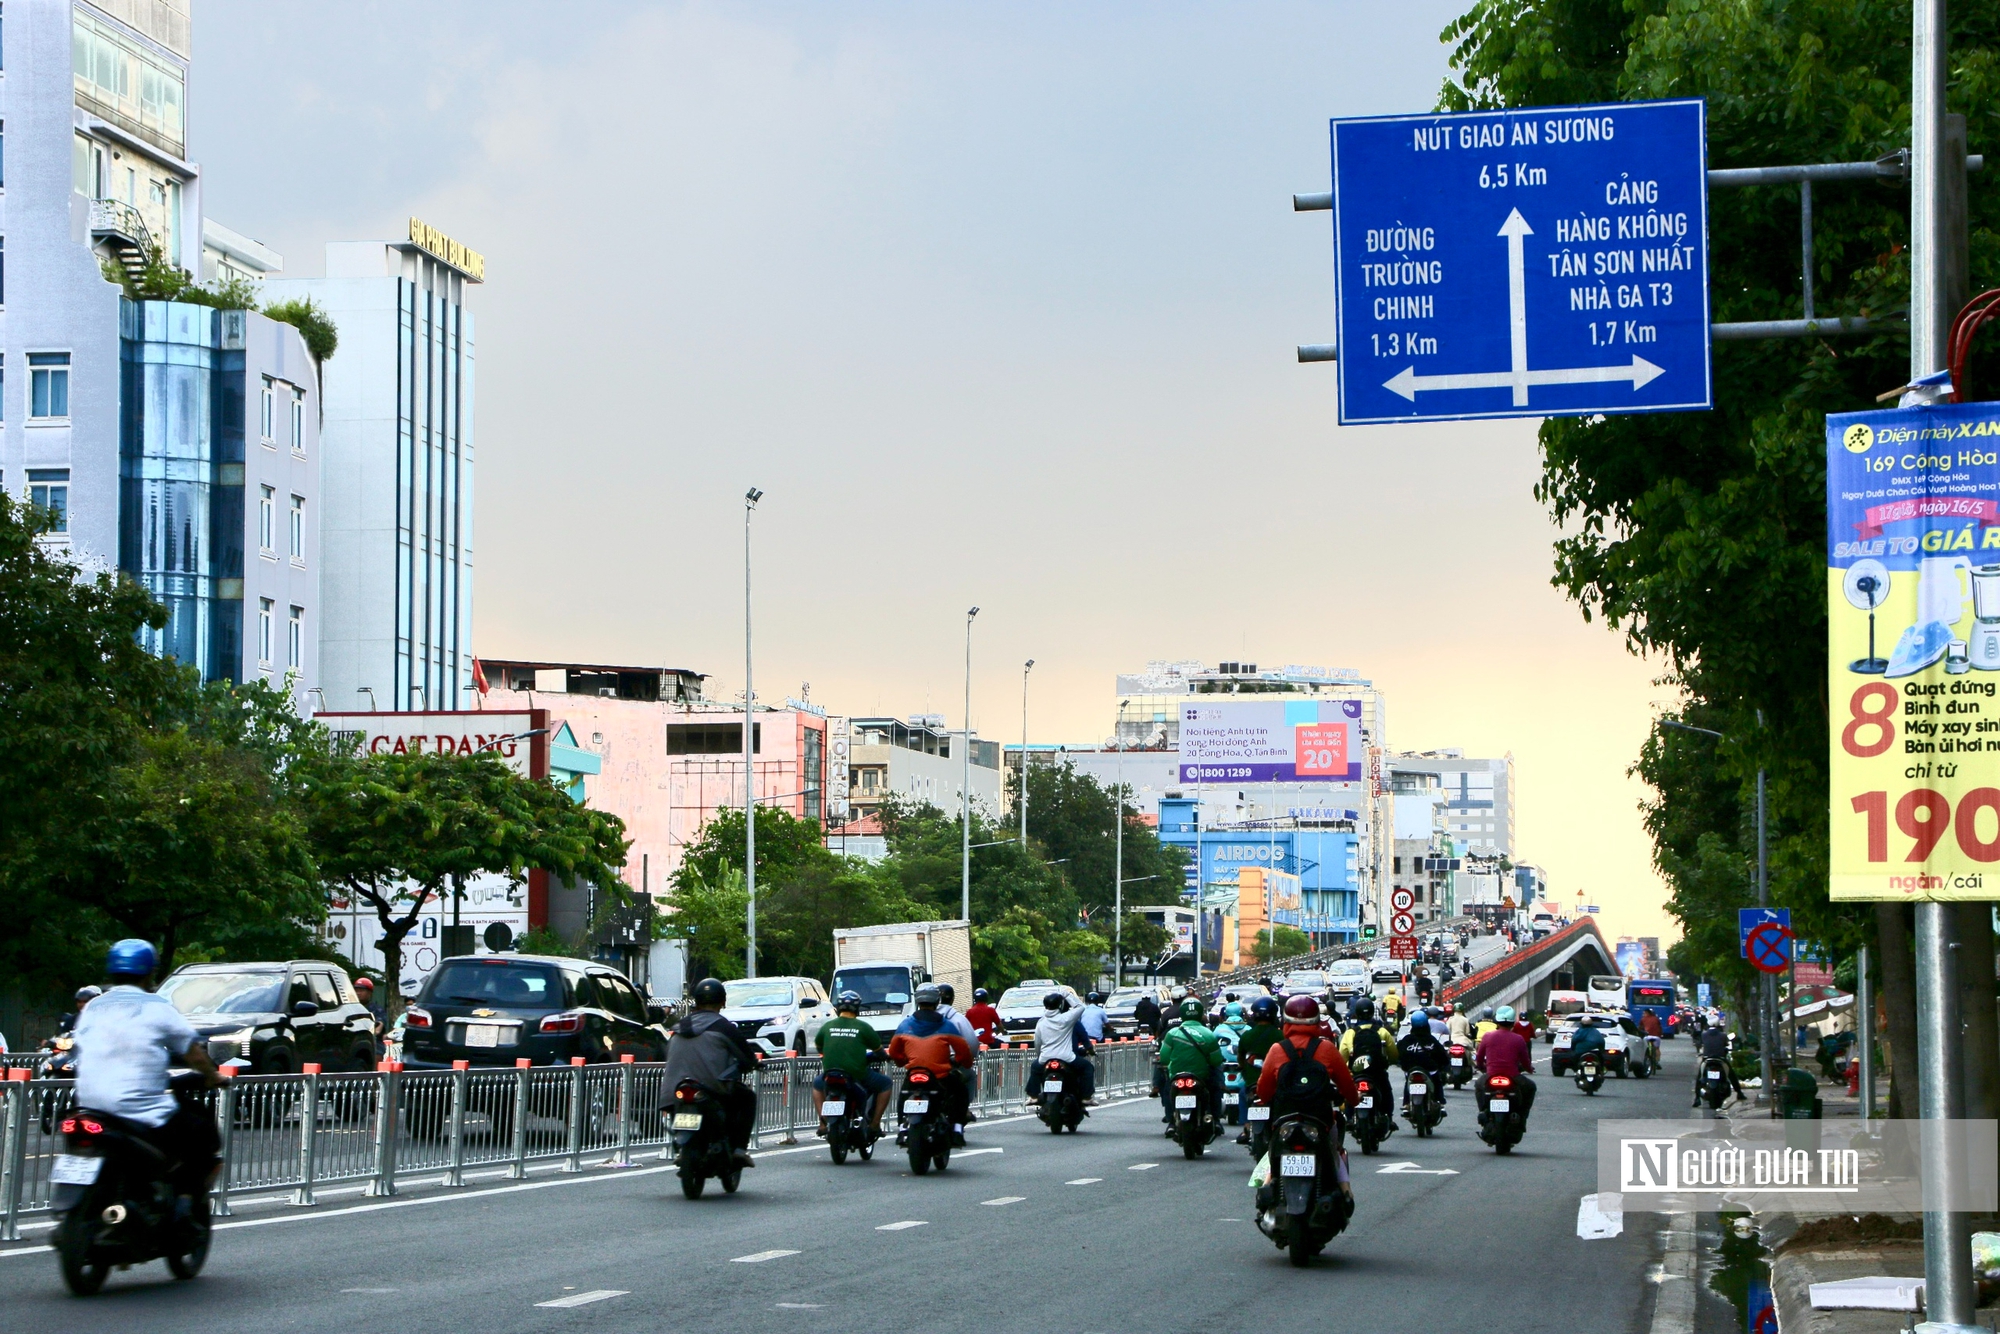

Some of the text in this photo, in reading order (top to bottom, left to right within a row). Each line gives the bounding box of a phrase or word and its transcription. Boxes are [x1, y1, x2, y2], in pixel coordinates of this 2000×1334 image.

[1414, 117, 1614, 151] NÚT GIAO AN SƯƠNG
[1479, 163, 1547, 189] 6,5 Km
[1606, 173, 1658, 205] CẢNG
[1366, 220, 1435, 252] ĐƯỜNG
[1556, 209, 1687, 243] HÀNG KHÔNG
[1549, 237, 1694, 278] TÂN SƠN NHẤT
[1361, 255, 1442, 287] TRƯỜNG
[1374, 295, 1433, 320] CHINH
[1570, 280, 1673, 311] NHÀ GA T3
[1371, 332, 1437, 358] 1,3 Km
[1589, 320, 1657, 346] 1,7 Km
[1877, 427, 1917, 446] Điện
[1865, 448, 1997, 473] 169 Cộng Hòa
[1914, 475, 1926, 484] 169
[1928, 474, 1951, 484] Cộng
[1952, 472, 1970, 481] Hòa
[1949, 483, 1977, 493] Hoàng
[1979, 482, 1997, 491] Hoa
[1920, 499, 1951, 515] ngày
[1951, 499, 1984, 514] 16/5
[1834, 540, 1886, 558] SALE
[1888, 536, 1919, 556] TO
[1921, 523, 1974, 552] GIÁ
[1904, 680, 1996, 699] Quạt đứng
[1841, 681, 1899, 758] 8
[1904, 699, 1980, 715] Bình đun
[1227, 727, 1244, 735] Anh
[1904, 719, 1938, 737] Máy
[1941, 722, 1972, 736] xay
[1186, 749, 1197, 757] 20
[1250, 738, 1267, 746] Anh
[1904, 738, 1936, 754] Bàn
[1939, 737, 1954, 753] ủi
[1956, 737, 1982, 752] hơi
[1200, 767, 1252, 777] 1800 1299
[1371, 755, 1381, 798] HOTEL
[1904, 762, 1958, 778] chỉ từ
[1851, 786, 2000, 862] 190
[1213, 845, 1285, 861] AIRDOG
